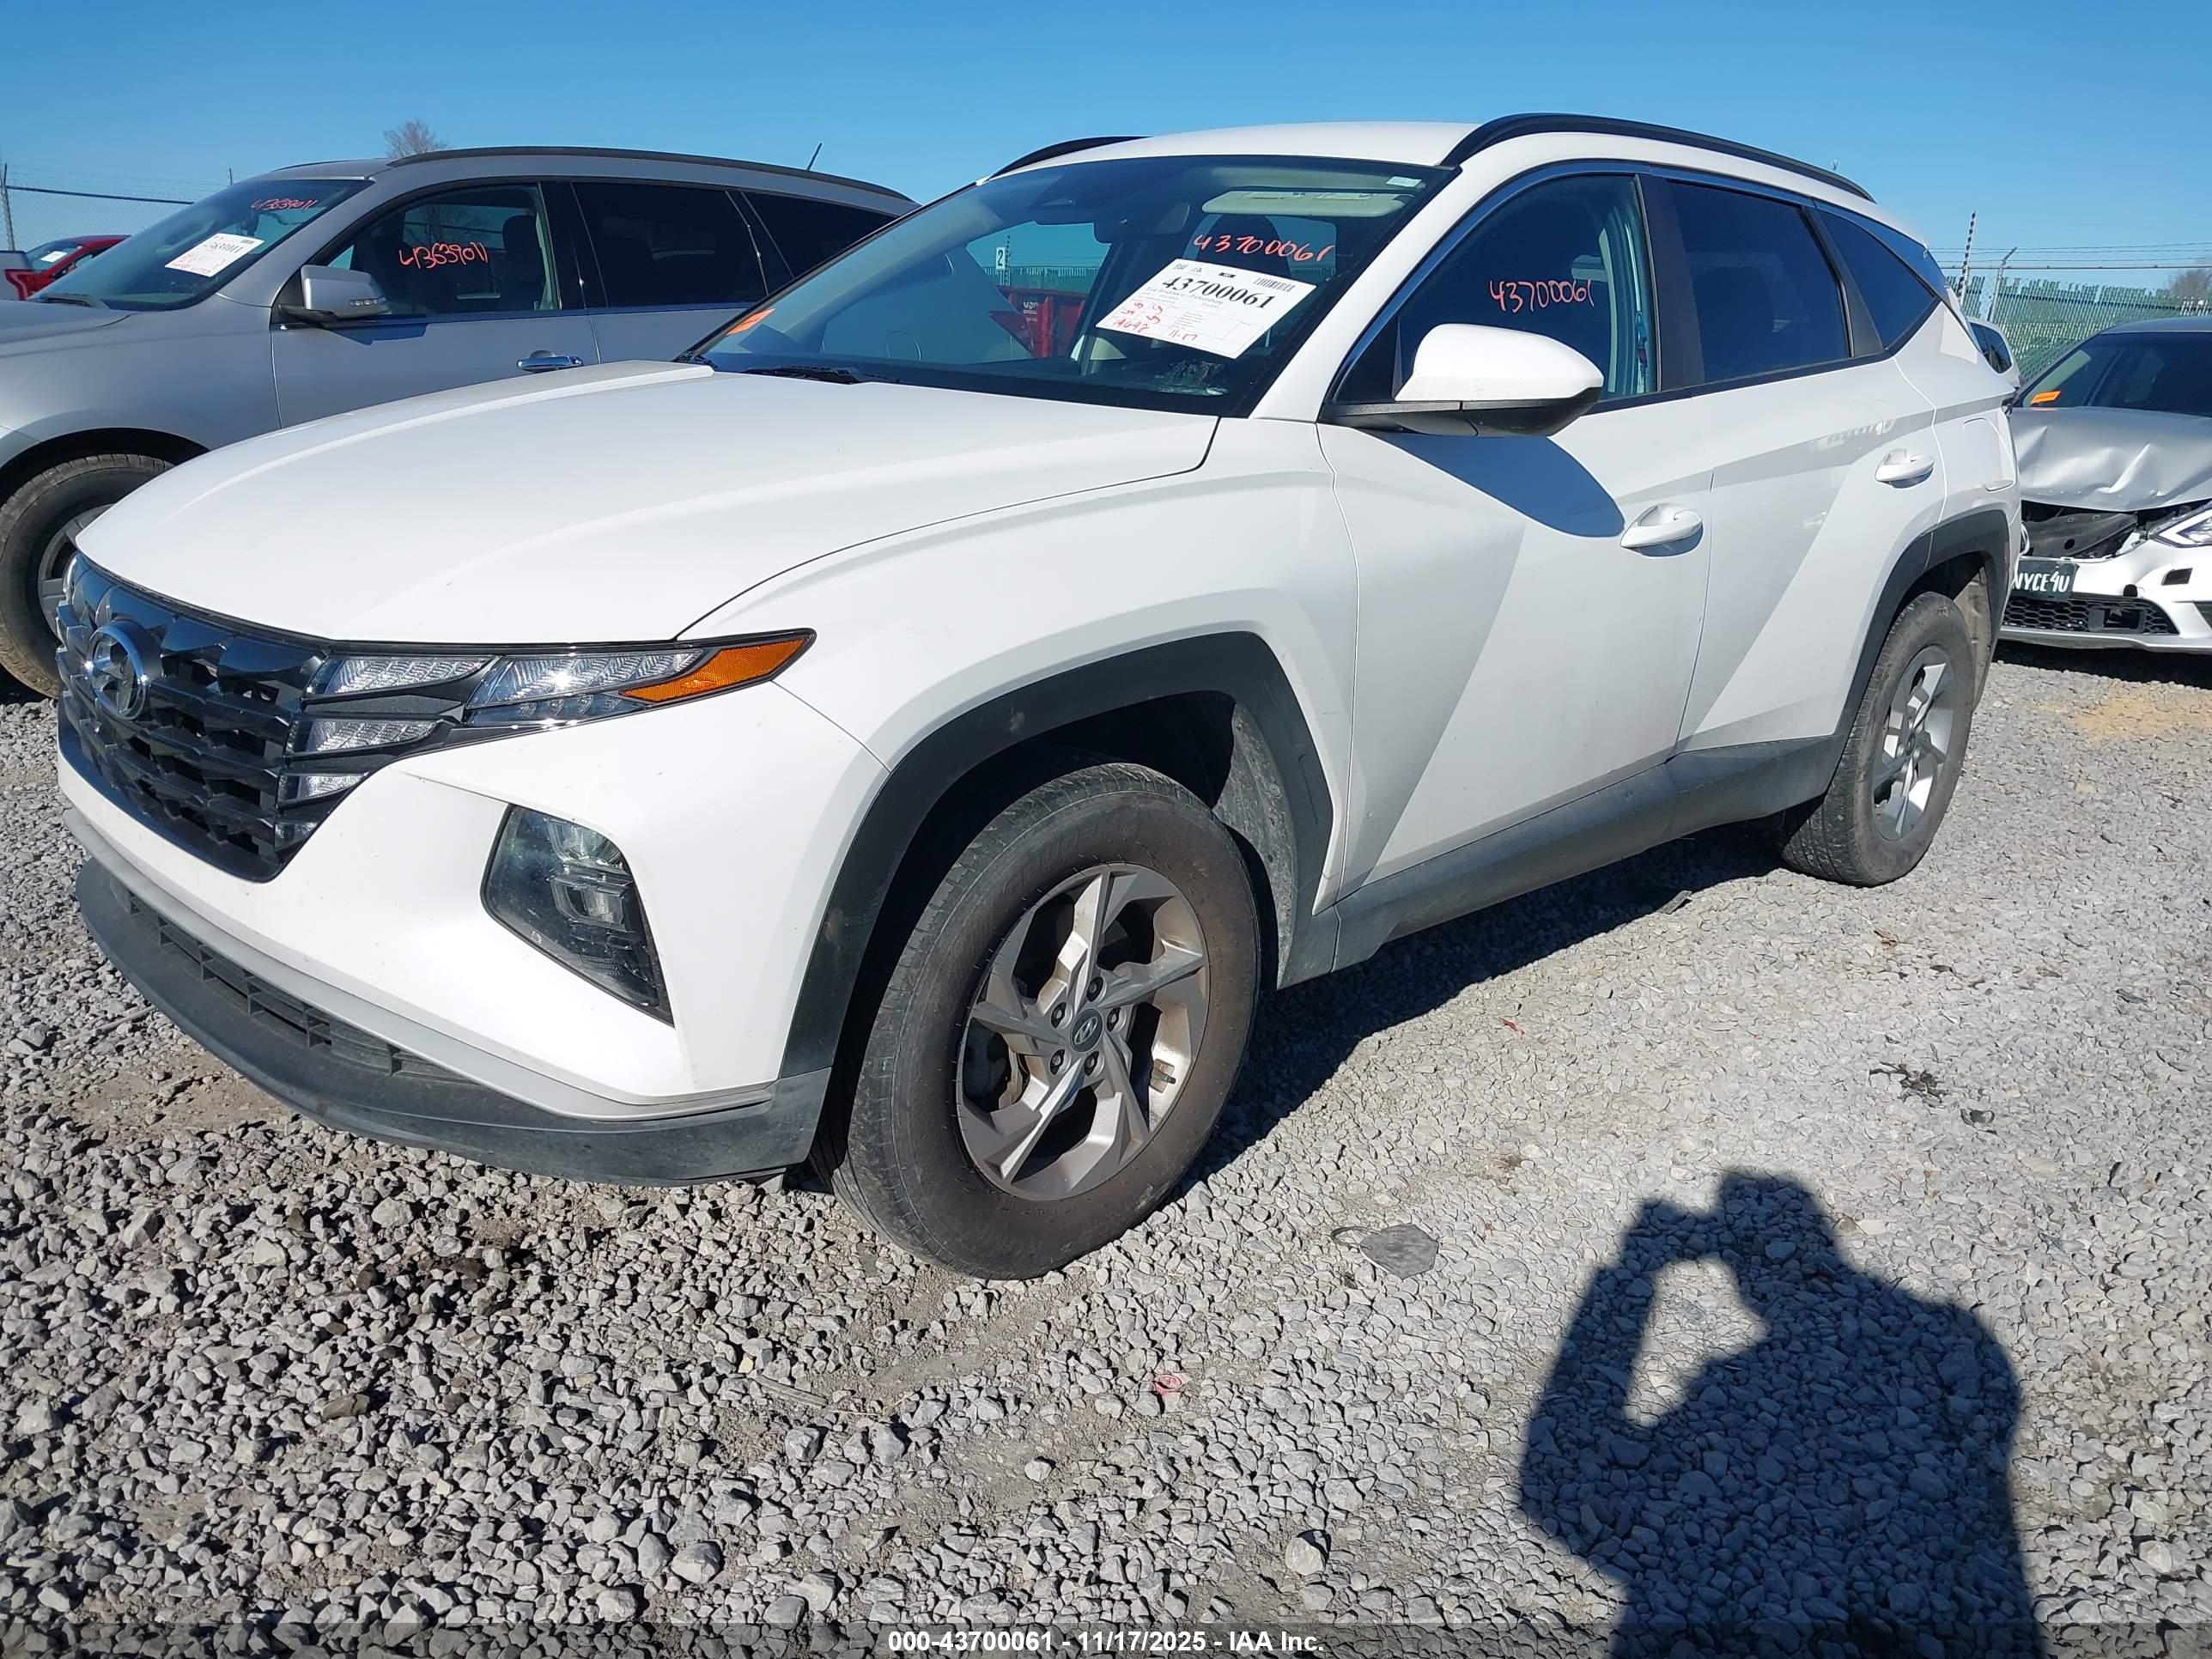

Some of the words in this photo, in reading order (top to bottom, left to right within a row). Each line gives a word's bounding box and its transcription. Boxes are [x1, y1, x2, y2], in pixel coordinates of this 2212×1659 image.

[398, 241, 489, 270] 43639011
[997, 249, 1004, 267] 2
[1193, 234, 1336, 262] 43700061
[1162, 276, 1276, 309] 43700061
[1489, 278, 1595, 313] 43700061
